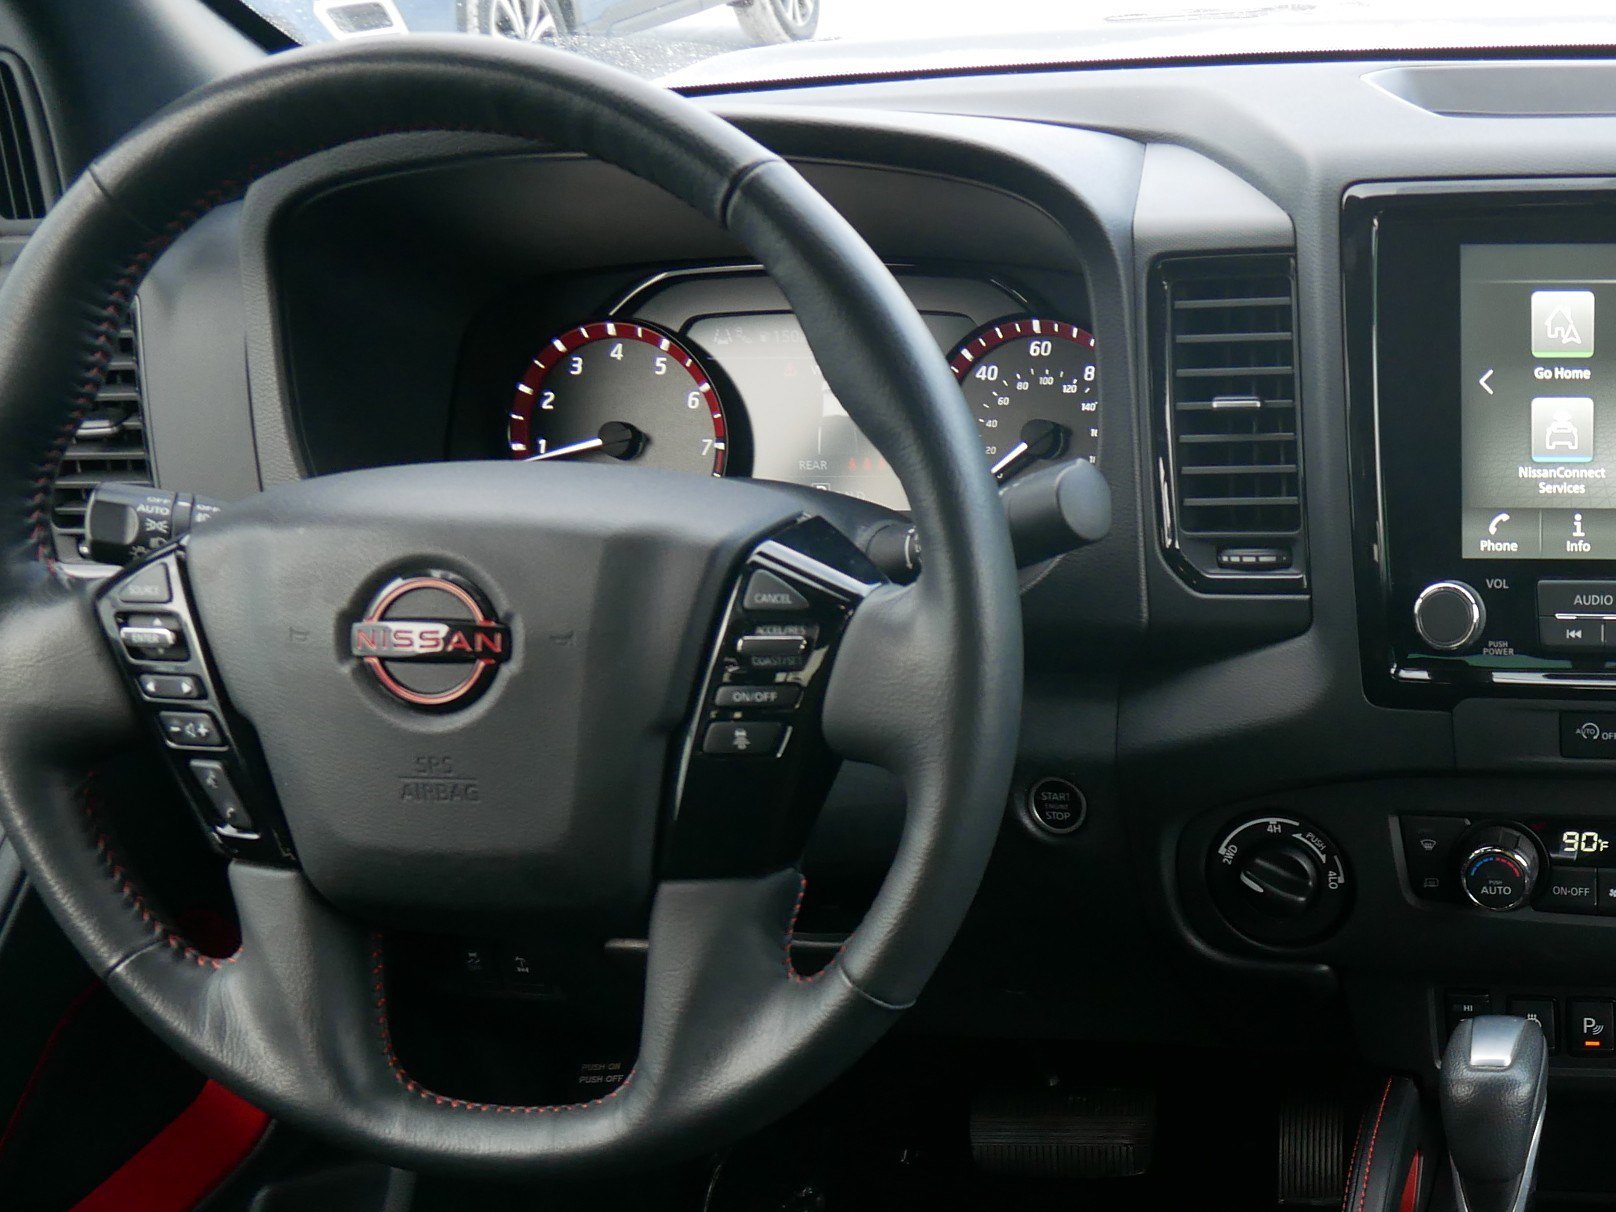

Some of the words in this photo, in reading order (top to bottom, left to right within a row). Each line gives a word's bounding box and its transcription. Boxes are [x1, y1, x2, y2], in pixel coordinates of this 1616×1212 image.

[610, 343, 623, 360] 4
[1029, 341, 1052, 356] 60
[570, 357, 583, 375] 3
[655, 357, 667, 375] 5
[975, 365, 998, 381] 40
[1534, 367, 1552, 380] Go
[1555, 367, 1591, 380] Home
[1016, 382, 1029, 390] 80
[1039, 377, 1054, 386] 100
[1062, 385, 1077, 393] 120
[541, 392, 555, 409] 2
[687, 391, 700, 409] 6
[997, 397, 1010, 406] 60
[985, 420, 998, 428] 40
[538, 439, 547, 454] 1
[702, 439, 713, 456] 7
[985, 446, 997, 455] 20
[799, 460, 828, 470] REAR
[1518, 467, 1606, 479] NissanConnect
[1538, 482, 1586, 494] Services
[137, 503, 170, 516] AUTO
[1480, 539, 1519, 552] Phone
[1566, 540, 1591, 552] Info
[1486, 578, 1509, 589] VOL
[754, 594, 792, 604] CANCEL
[1573, 595, 1614, 606] AUDIO
[356, 629, 502, 653] NISSAN
[1488, 640, 1508, 648] PUSH
[1483, 648, 1514, 656] POWER
[400, 783, 480, 801] AIRBAG
[1266, 825, 1282, 834] 4H
[1305, 832, 1327, 851] PUSH
[1222, 844, 1238, 865] 2WD
[1327, 870, 1339, 890] 4LO
[1480, 886, 1512, 895] AUTO
[1552, 886, 1590, 896] ON-OFF
[1463, 1004, 1473, 1012] HI
[1583, 1017, 1596, 1034] P
[581, 1063, 605, 1071] PUSH
[579, 1075, 603, 1083] PUSH
[606, 1074, 624, 1083] OFF
